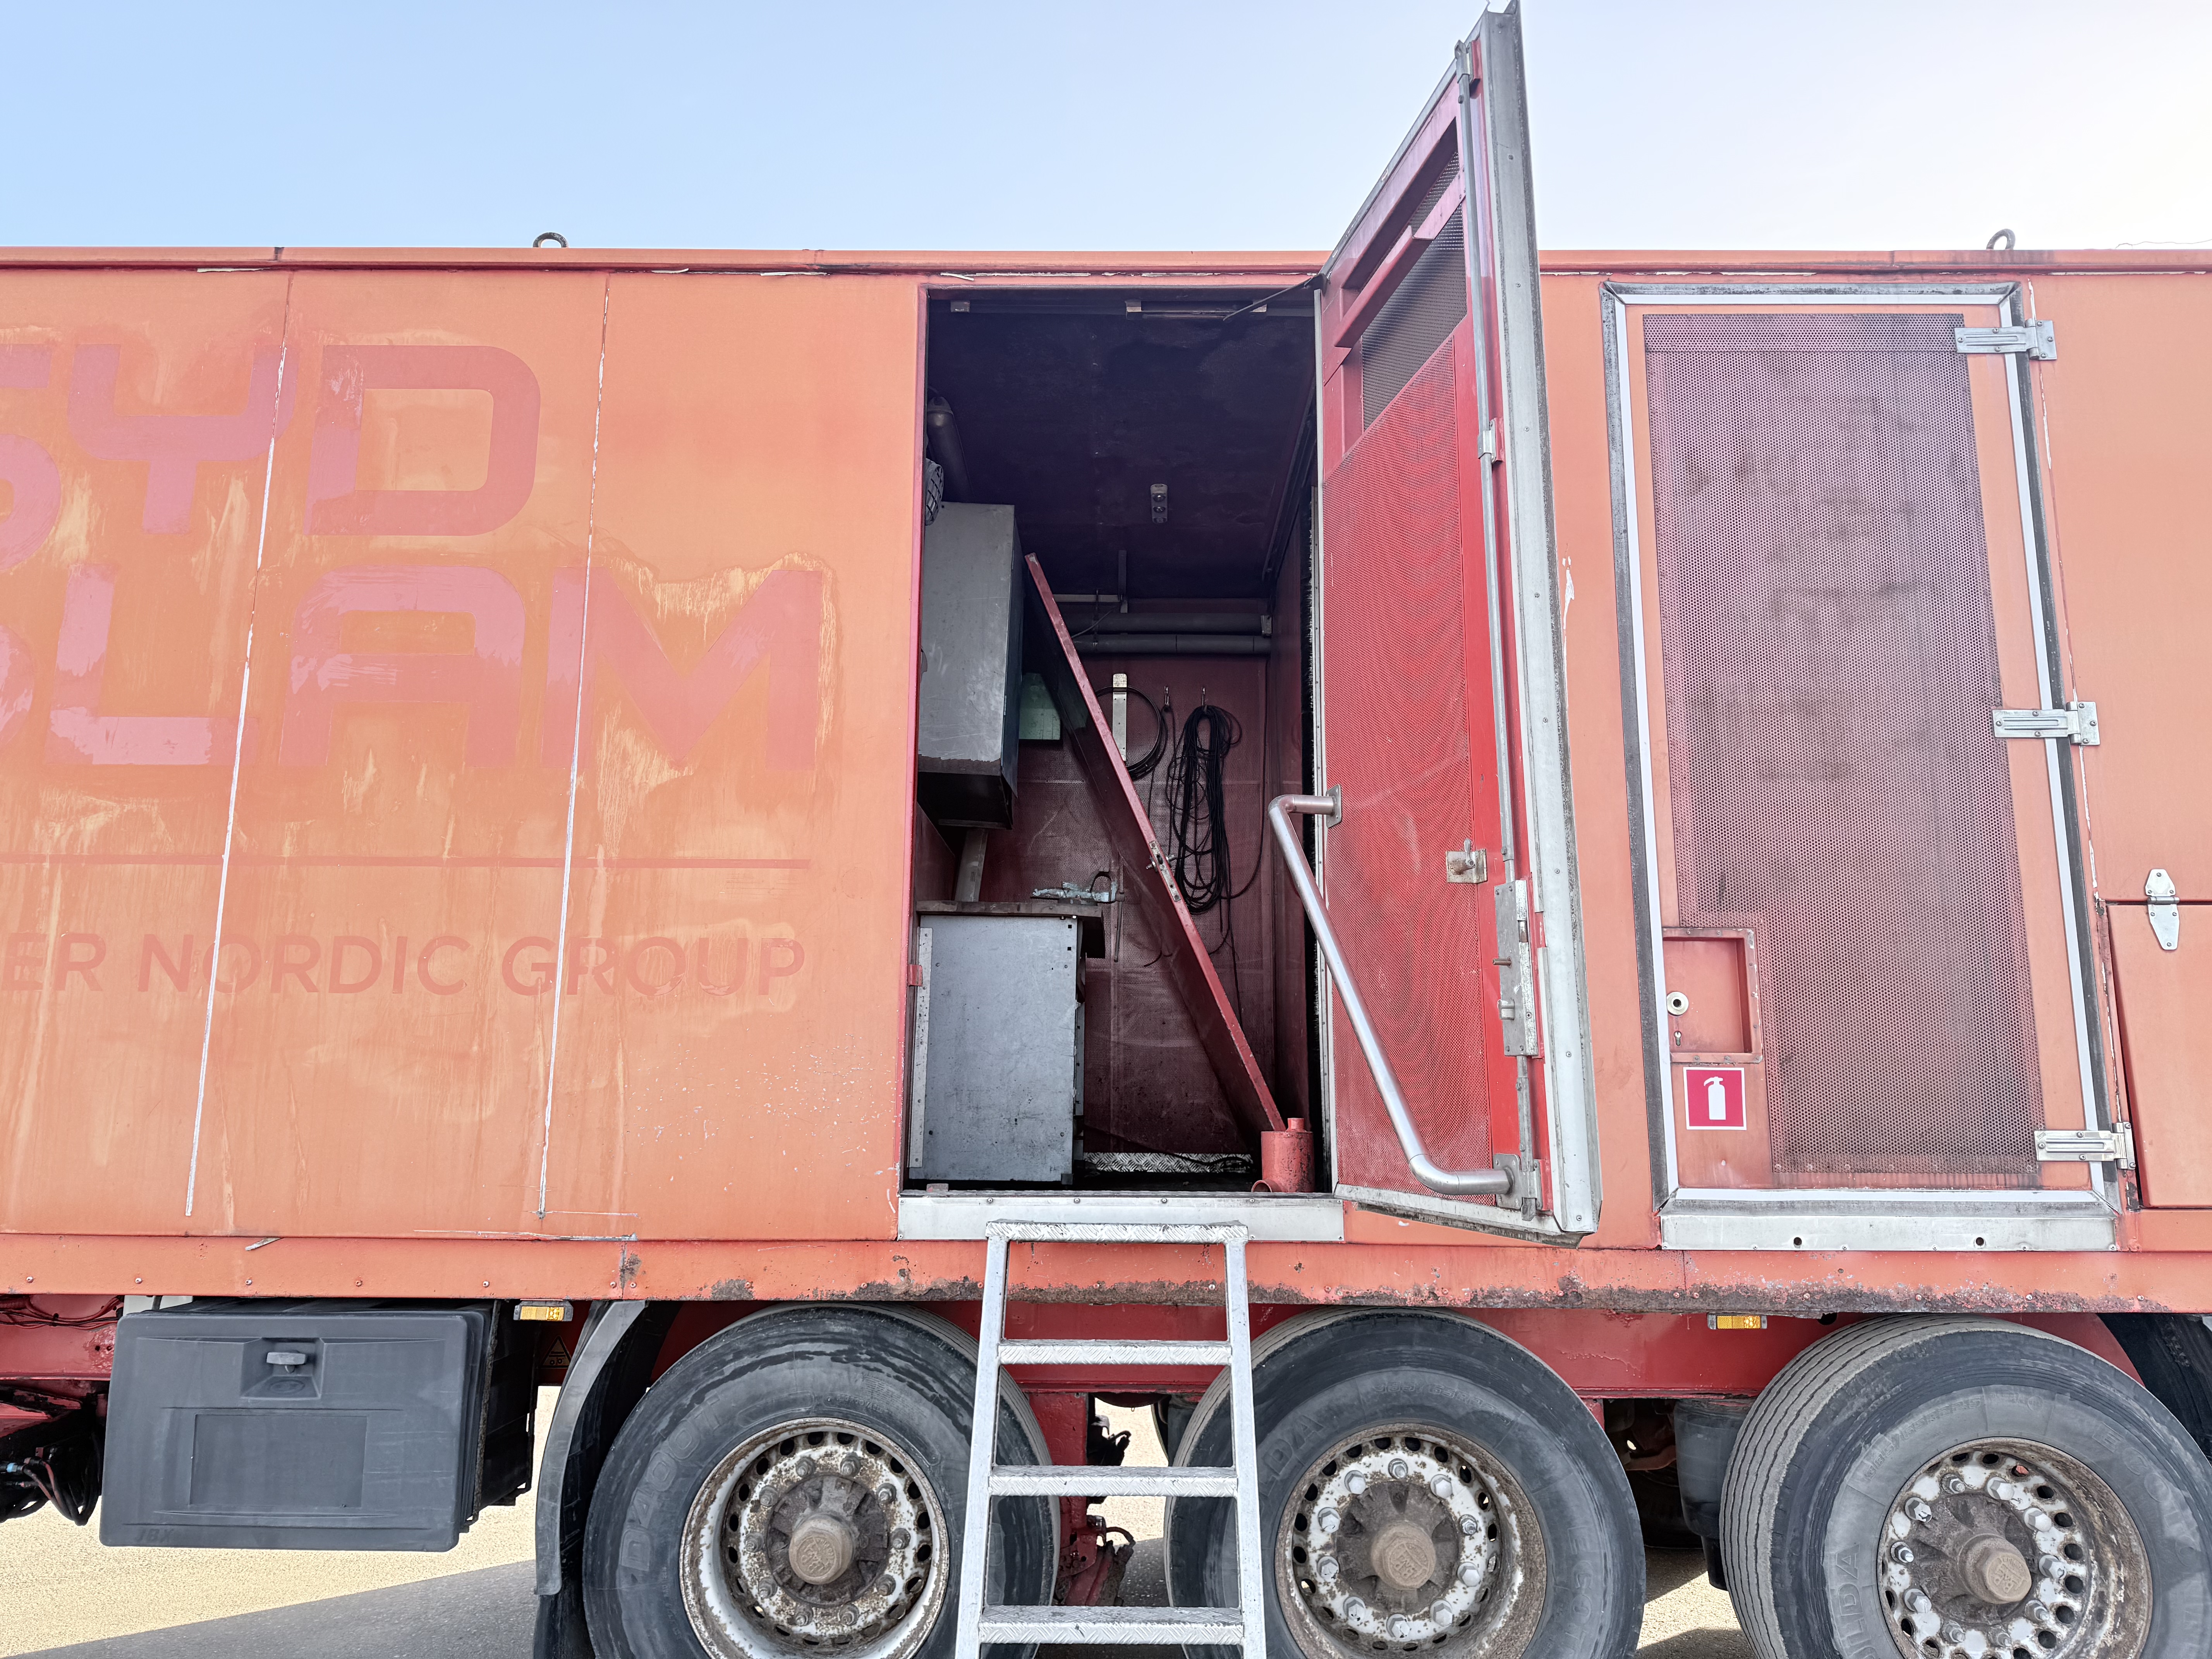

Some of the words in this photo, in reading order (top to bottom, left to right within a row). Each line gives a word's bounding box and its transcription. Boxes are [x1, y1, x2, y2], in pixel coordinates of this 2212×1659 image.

[0, 343, 541, 572] YD
[0, 565, 823, 773] LAM
[137, 934, 471, 996] NORDIC
[502, 936, 805, 996] GROUP
